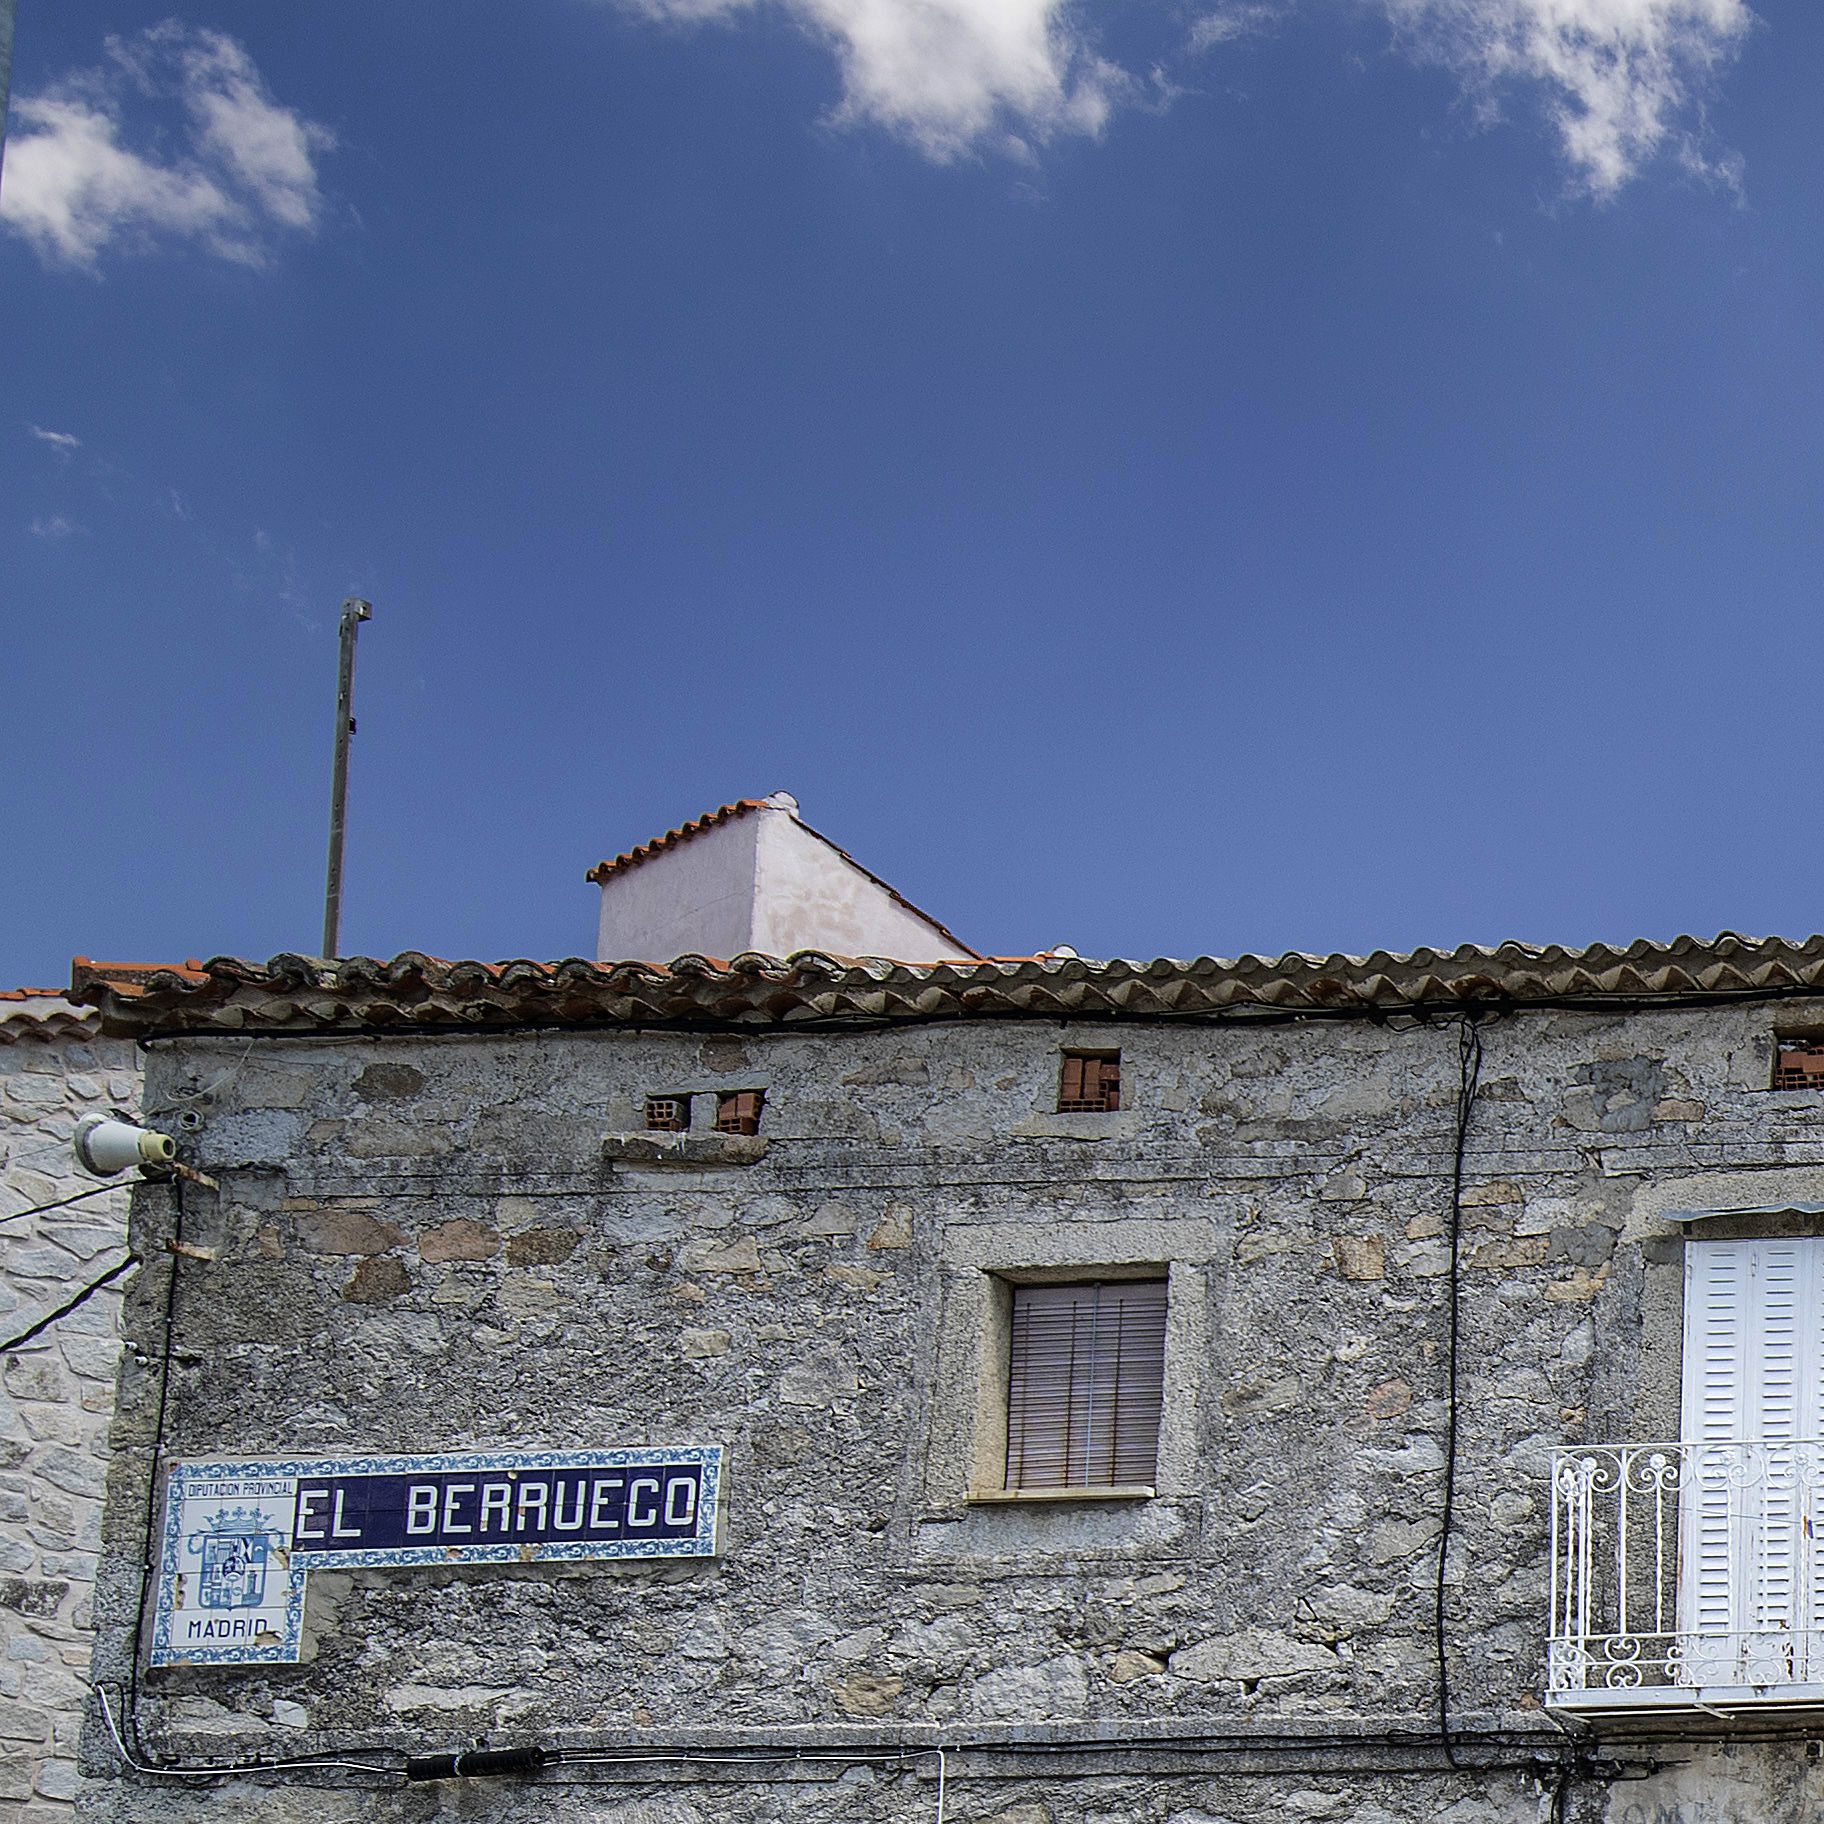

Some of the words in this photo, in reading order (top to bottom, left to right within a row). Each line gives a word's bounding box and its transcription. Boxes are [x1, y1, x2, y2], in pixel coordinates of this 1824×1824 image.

[188, 1483, 239, 1497] DIPUTACION
[243, 1481, 293, 1496] PROVINCIAL
[296, 1489, 362, 1539] EL
[406, 1476, 699, 1535] BERRUECO
[188, 1619, 268, 1639] MADRID
